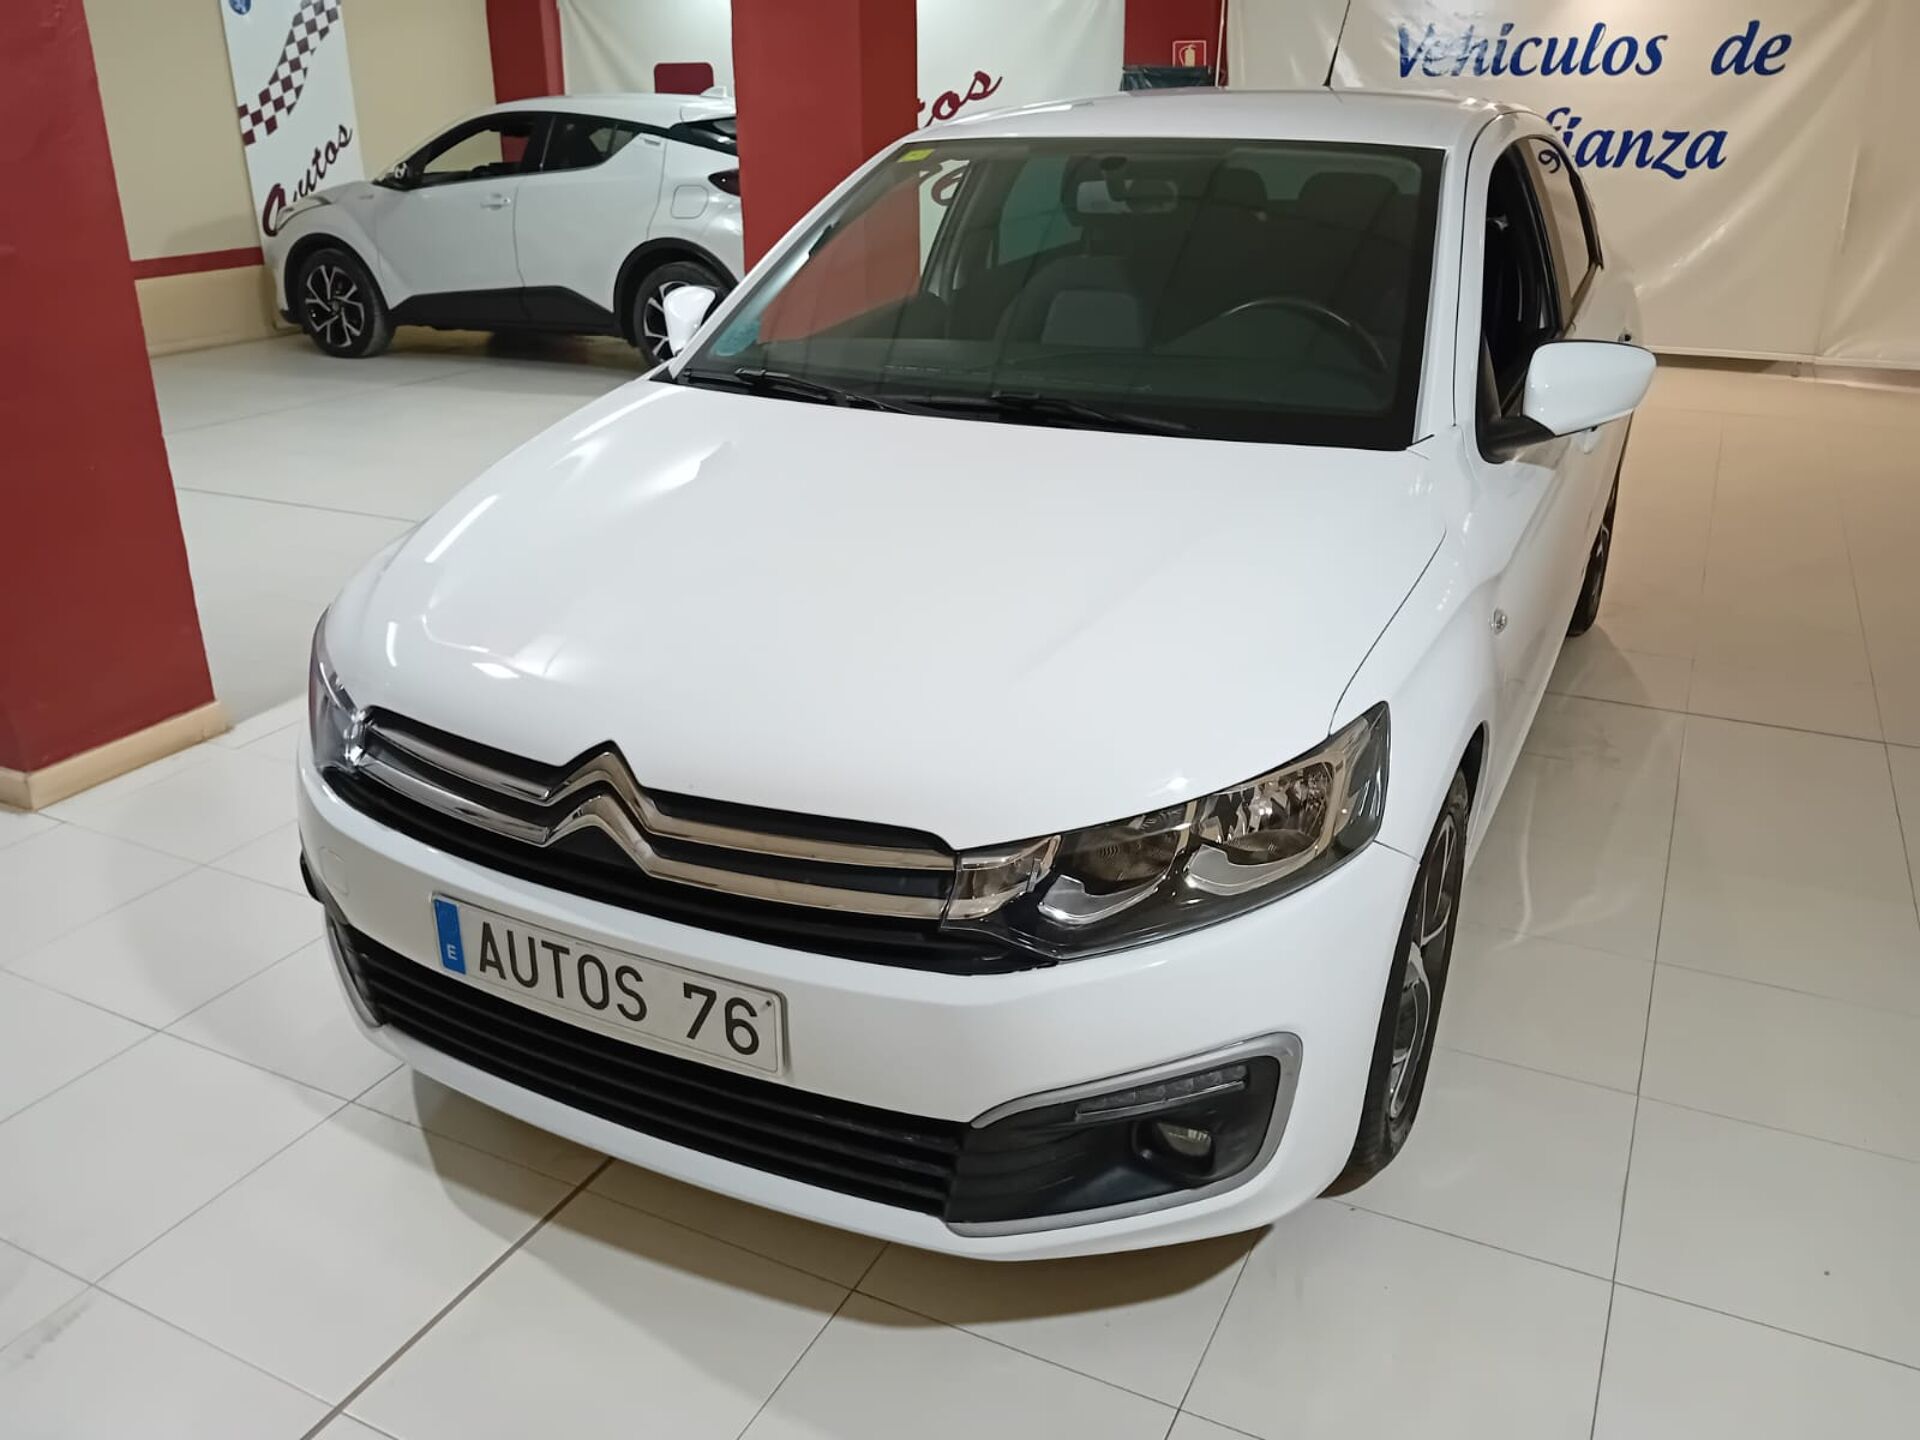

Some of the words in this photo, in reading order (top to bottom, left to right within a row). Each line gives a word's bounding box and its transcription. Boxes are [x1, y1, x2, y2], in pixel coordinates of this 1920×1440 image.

[1711, 20, 1792, 76] de
[446, 943, 458, 961] E
[479, 921, 648, 1022] AUTOS
[683, 982, 760, 1056] 76
